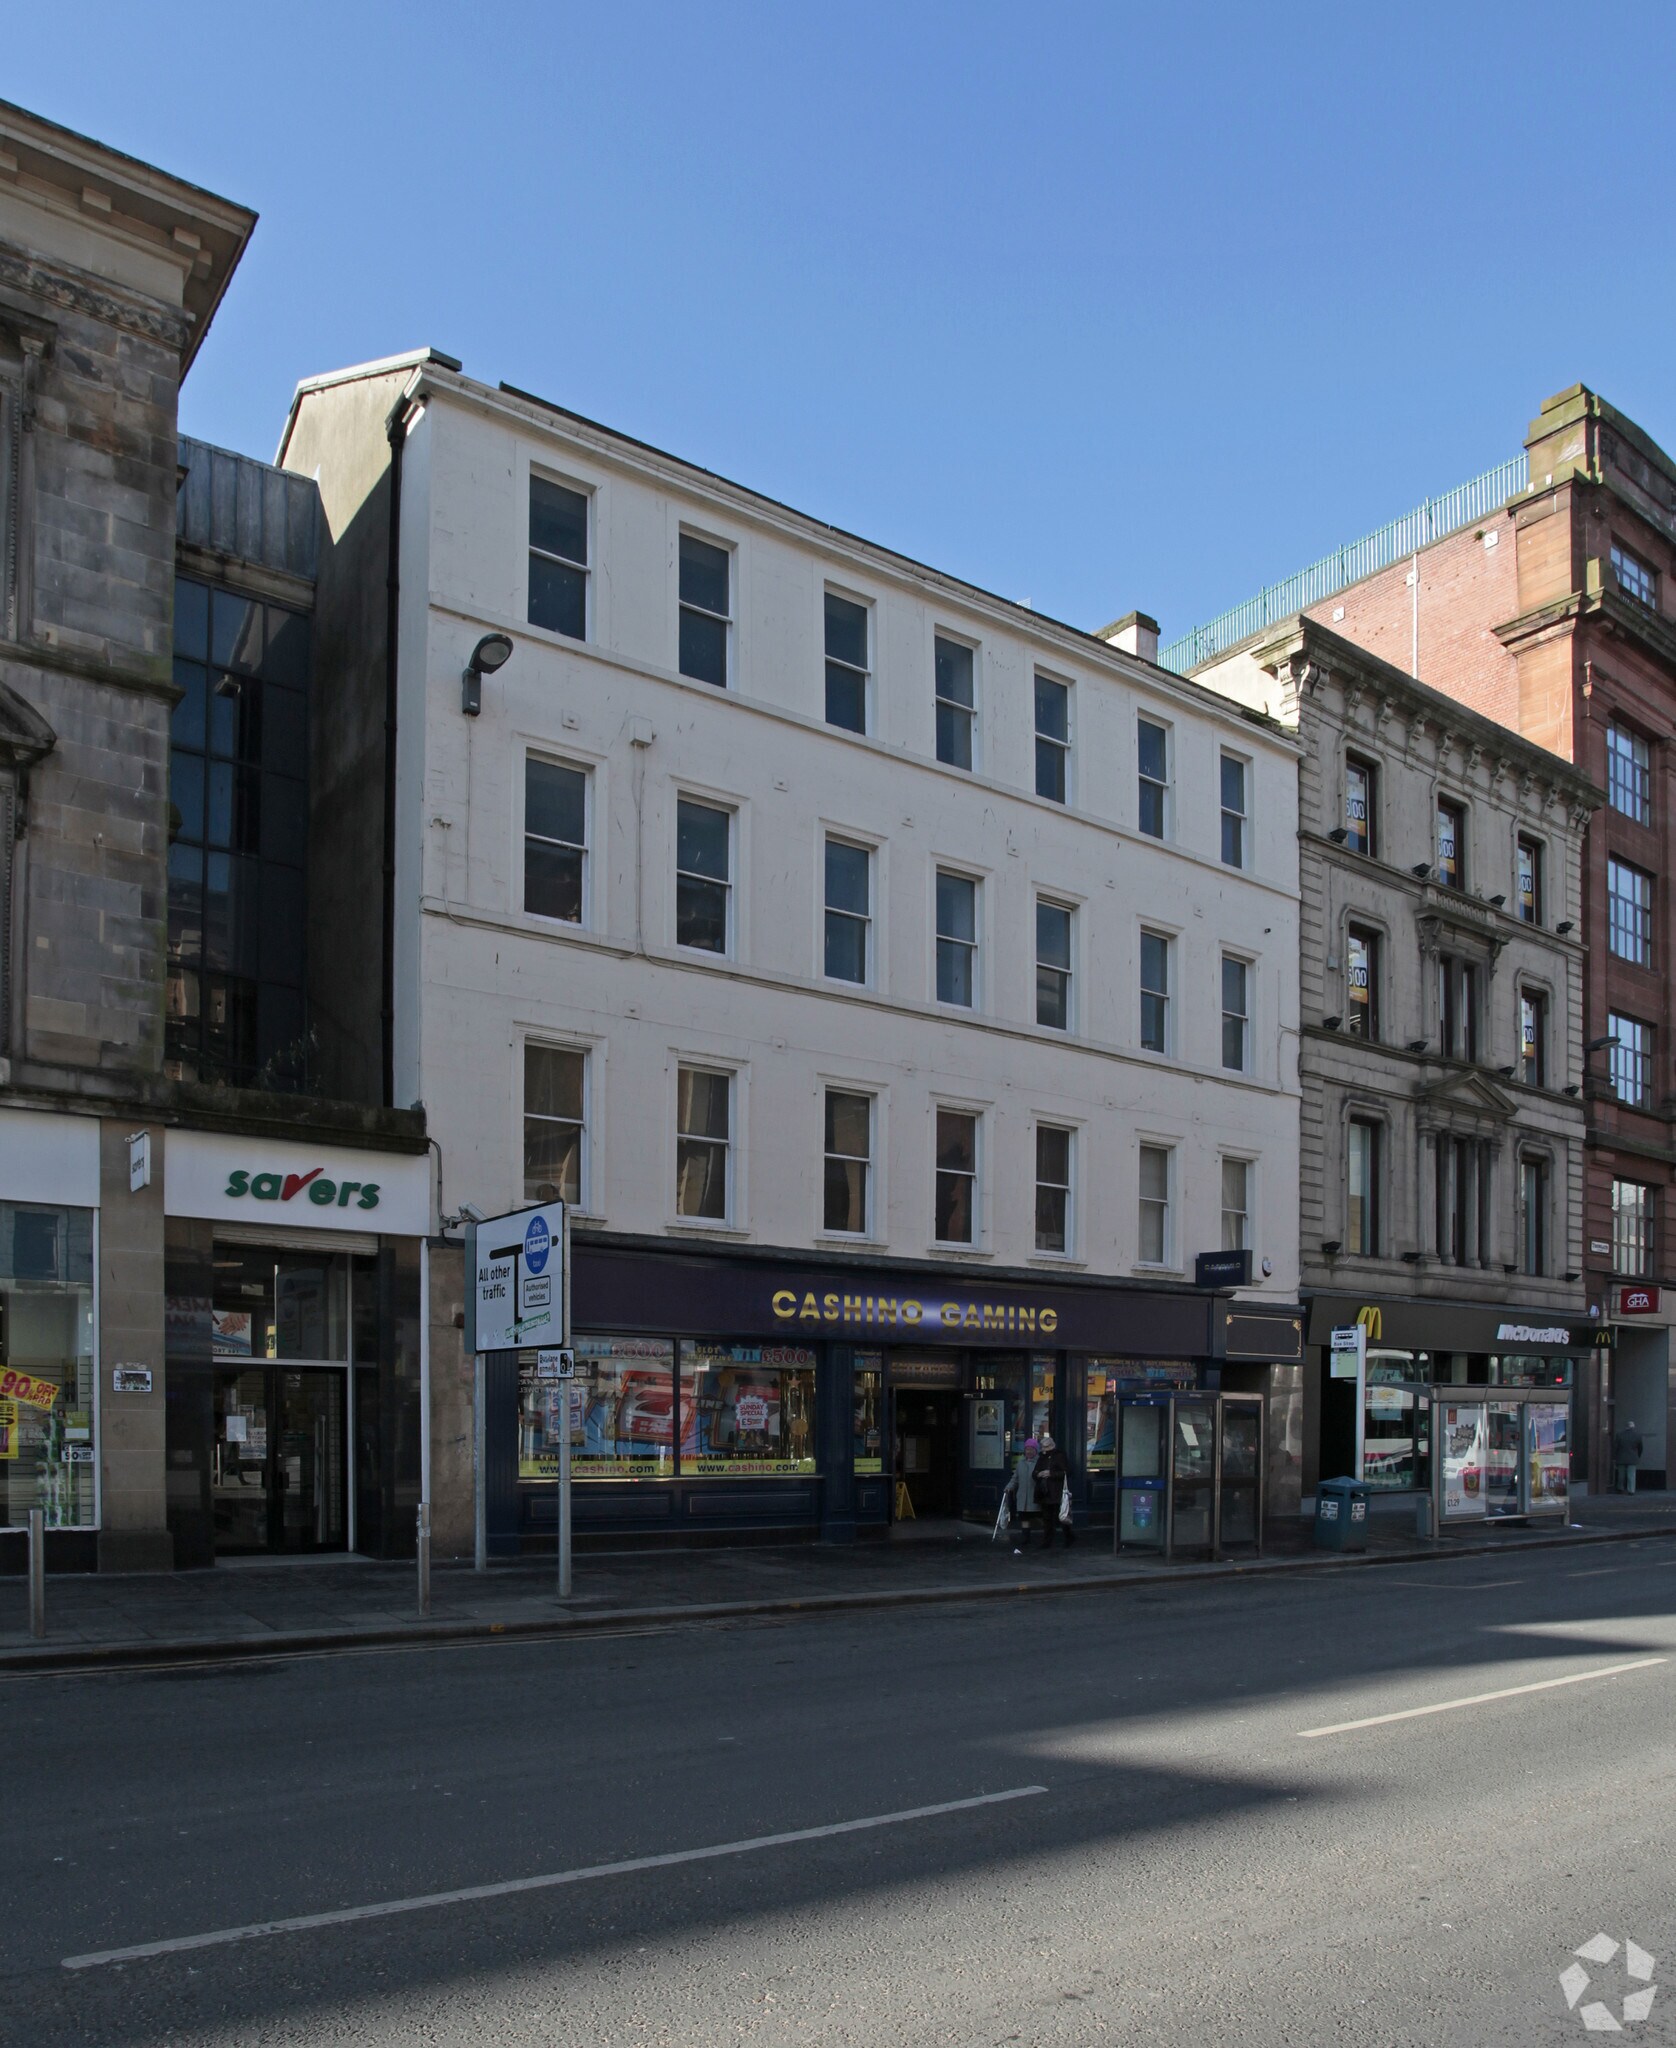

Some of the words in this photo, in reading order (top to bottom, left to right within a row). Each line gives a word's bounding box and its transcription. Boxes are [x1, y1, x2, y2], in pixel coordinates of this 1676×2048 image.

[225, 1168, 380, 1209] savers
[478, 1266, 489, 1282] All
[491, 1265, 511, 1280] other
[483, 1285, 506, 1300] traffic
[525, 1281, 549, 1293] Authorised
[528, 1290, 546, 1302] vehicles
[1627, 1297, 1649, 1308] GHA
[772, 1289, 923, 1326] CASHINO
[940, 1302, 1058, 1333] GAMING
[1497, 1324, 1570, 1344] McDonald's
[731, 1347, 762, 1363] WIN
[762, 1347, 809, 1364] £500
[539, 1463, 655, 1474] ww.cashino.com
[697, 1463, 798, 1473] www.cashino.com
